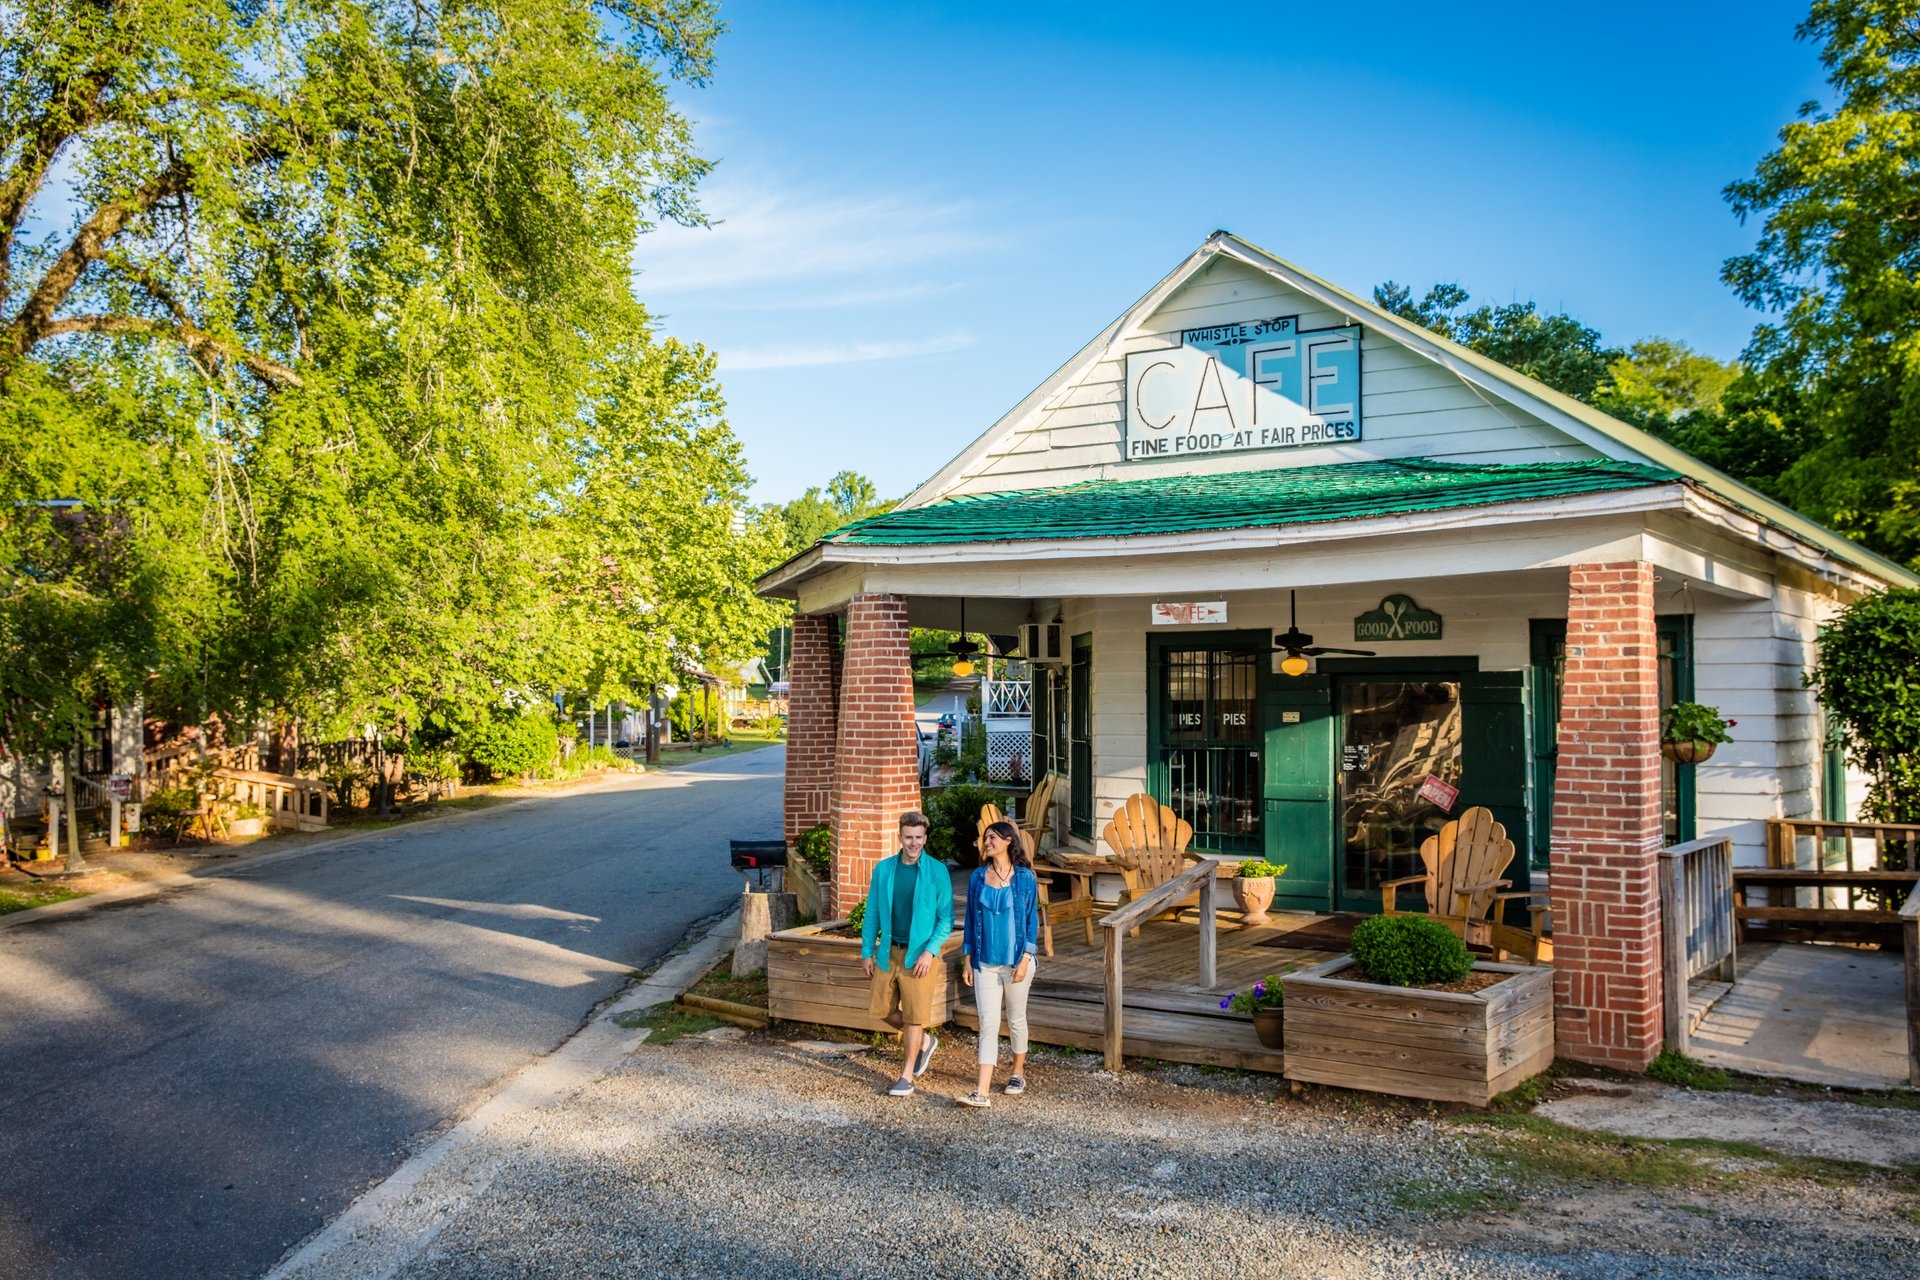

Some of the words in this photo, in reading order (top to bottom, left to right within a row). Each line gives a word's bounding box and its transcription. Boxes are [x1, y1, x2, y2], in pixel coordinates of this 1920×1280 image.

[1188, 326, 1247, 343] WHISTLE
[1254, 320, 1290, 336] STOP
[1132, 333, 1354, 434] CAFE
[1131, 438, 1168, 456] FINE
[1175, 433, 1222, 450] FOOD
[1233, 430, 1254, 447] AT
[1261, 426, 1295, 444] FAIR
[1301, 421, 1355, 442] PRICES
[1357, 622, 1389, 636] GOOD
[1404, 620, 1438, 634] FOOD
[1179, 713, 1201, 726] PIES
[1222, 713, 1246, 726] PIES
[1423, 784, 1450, 806] OPEN
